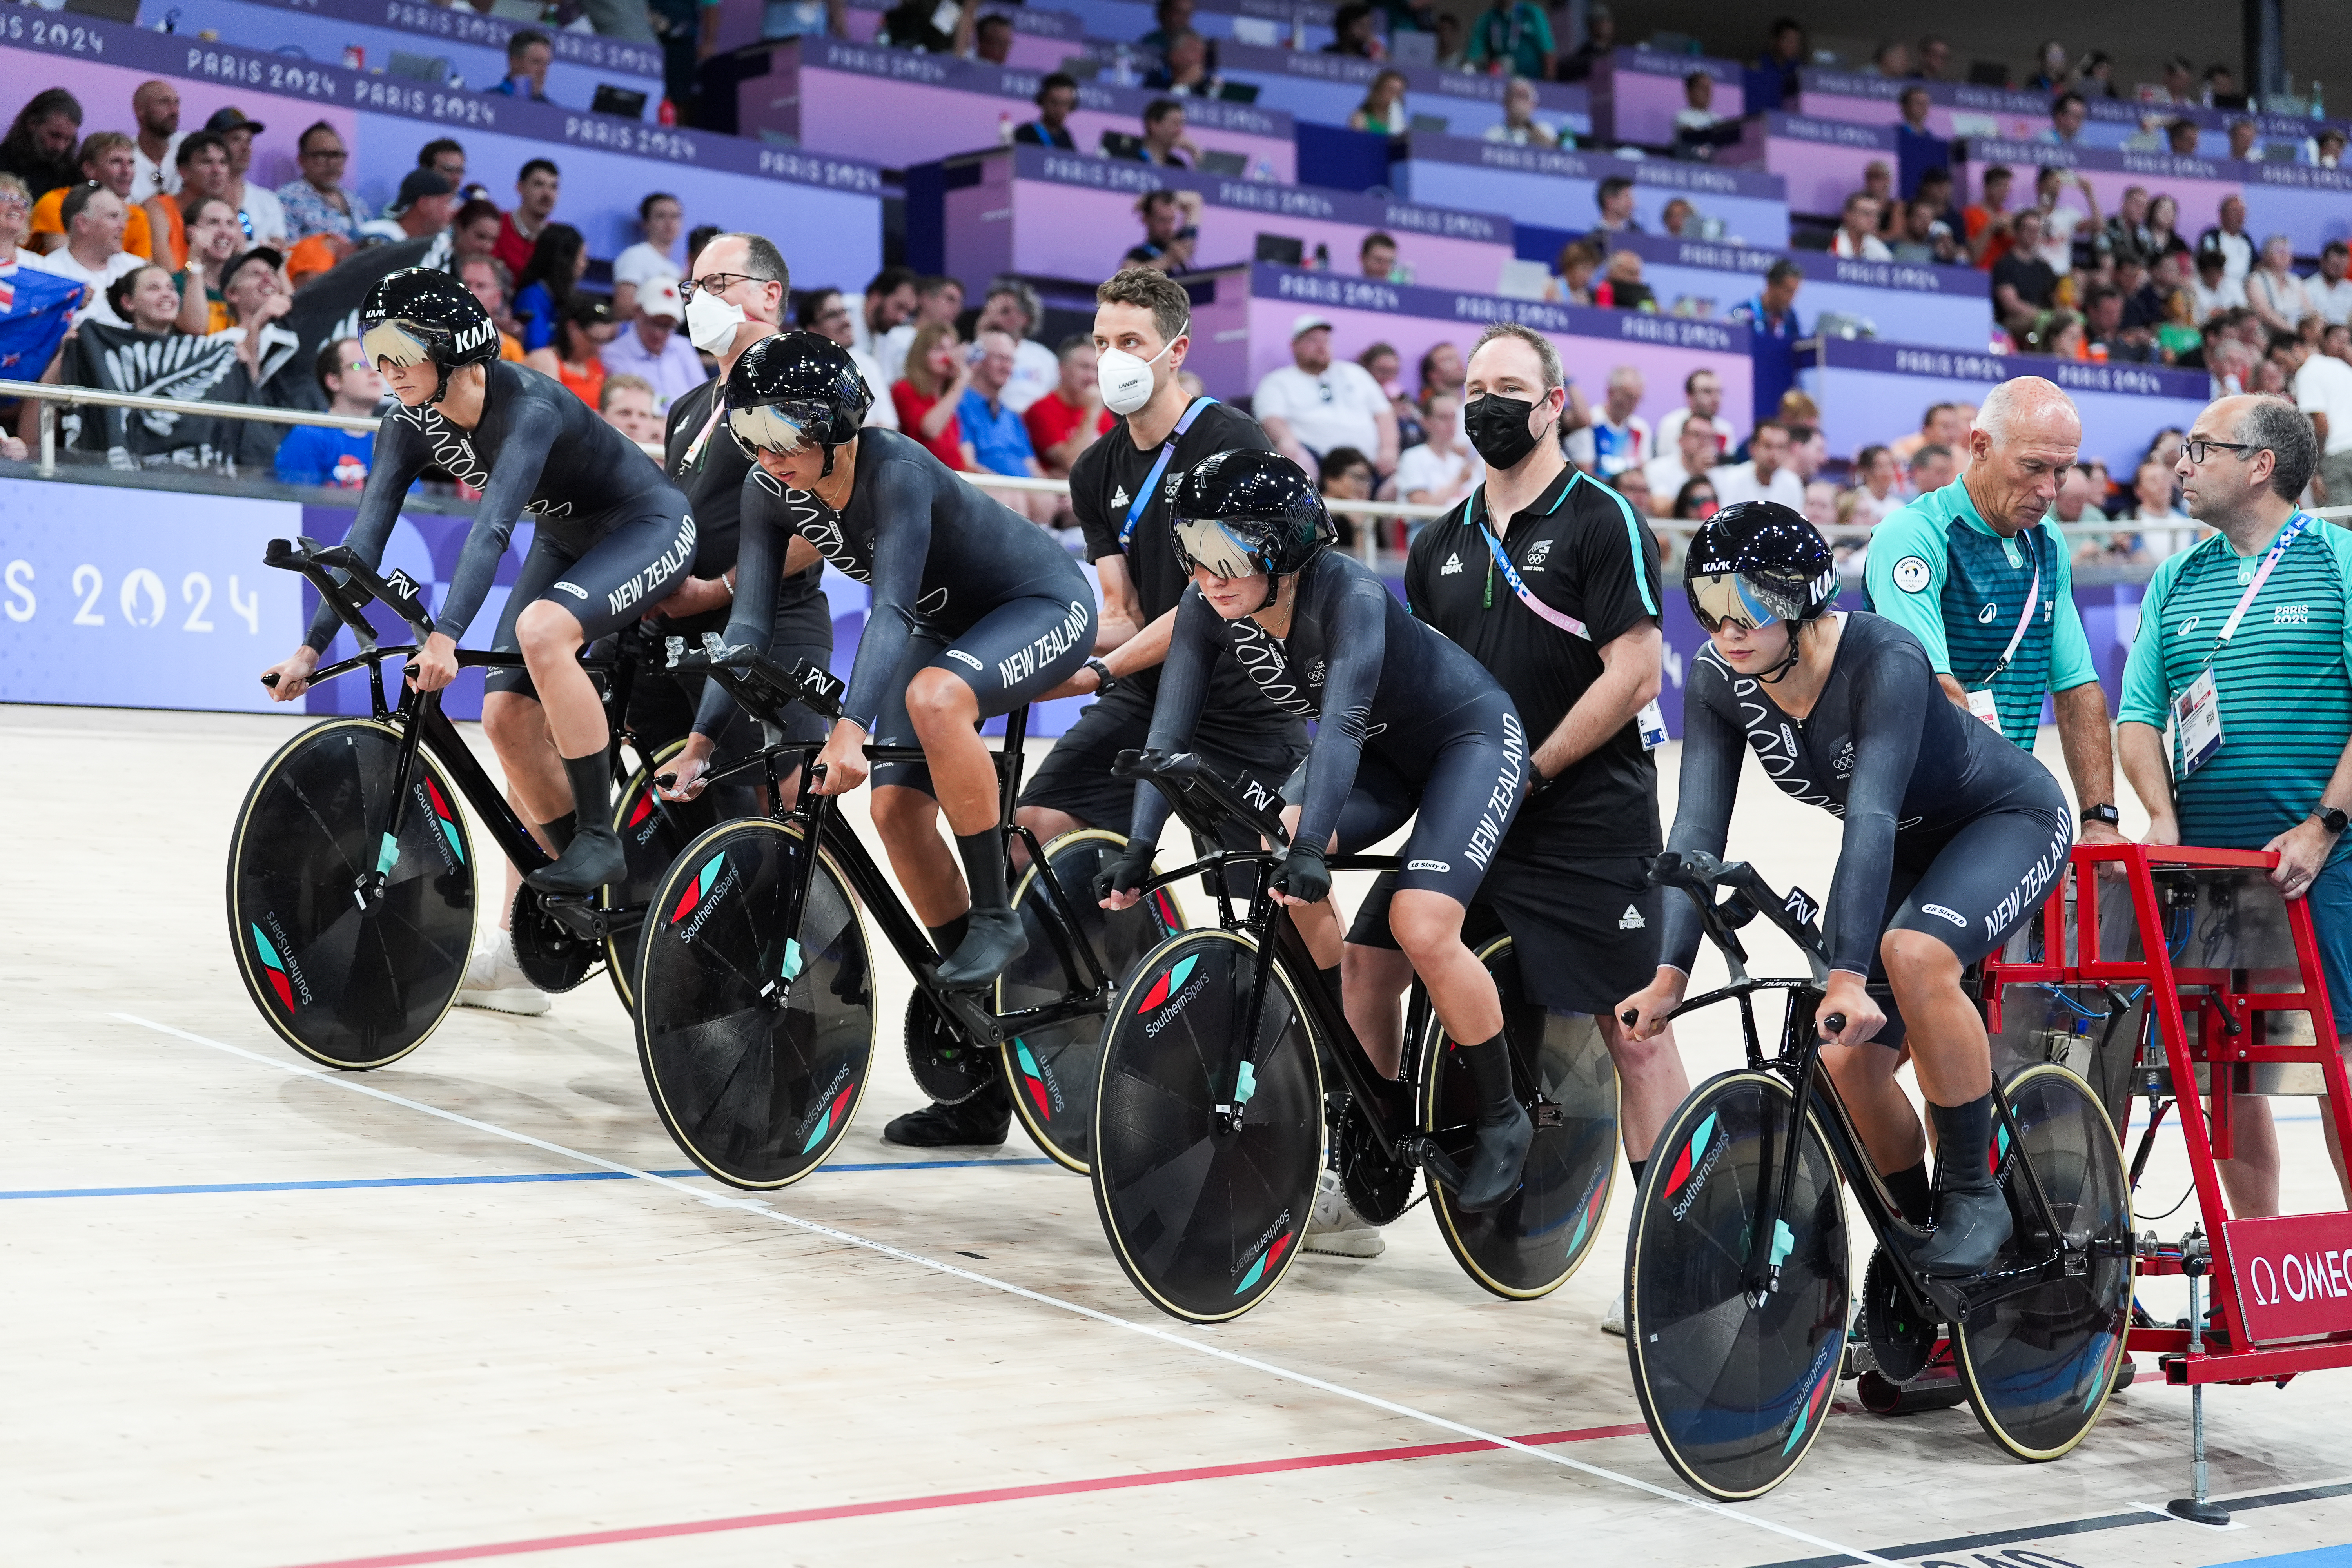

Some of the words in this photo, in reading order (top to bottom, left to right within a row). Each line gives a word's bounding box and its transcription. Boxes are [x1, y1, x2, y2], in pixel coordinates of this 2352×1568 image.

[32, 20, 103, 54] 2024
[187, 48, 262, 84] PARIS
[269, 64, 335, 97] 2024
[355, 80, 425, 113] PARIS
[431, 93, 495, 125] 2024
[566, 116, 632, 149] PARIS
[637, 129, 697, 159] 2024
[1111, 494, 1130, 508] PEAK
[608, 574, 642, 616] NEW
[643, 514, 696, 592] ZEALAND
[1441, 562, 1464, 576] PEAK
[1702, 561, 1731, 572] KASK
[1900, 559, 1924, 569] VOLONTAIRE
[72, 563, 259, 635] 2024
[1529, 598, 1549, 616] 2024
[2275, 604, 2309, 615] PARIS
[1550, 613, 1576, 629] PARIS
[2273, 614, 2308, 625] 2024
[998, 644, 1034, 689] NEW
[1034, 600, 1088, 669] ZEALAND
[959, 654, 975, 664] Sixty
[1841, 746, 1854, 755] TEAM
[1464, 812, 1500, 871] NEW
[1487, 712, 1523, 823] ZEALAND
[1984, 886, 2020, 942] NEW
[2020, 806, 2071, 909] ZEALAND
[1938, 908, 1958, 921] Sixty
[1619, 917, 1646, 930] PEAK
